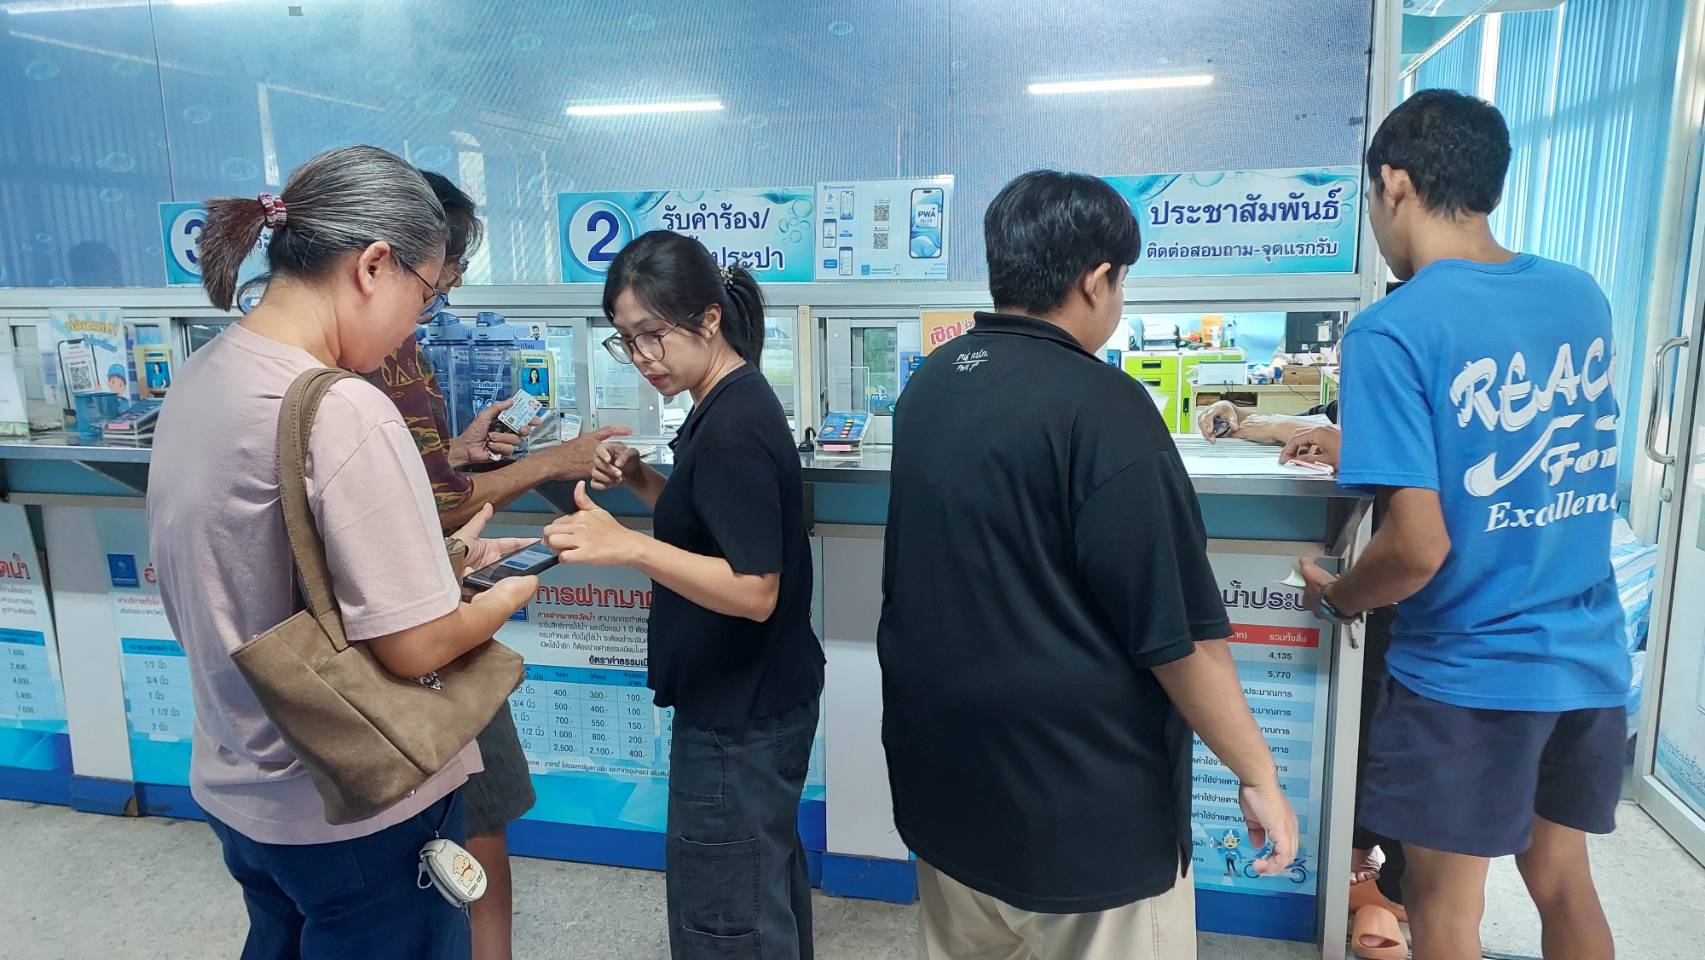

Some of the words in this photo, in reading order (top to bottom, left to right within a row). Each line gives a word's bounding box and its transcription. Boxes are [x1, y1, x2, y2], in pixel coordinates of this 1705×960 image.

[662, 202, 771, 230] รับคำร้อง/
[917, 209, 937, 218] PWA
[1151, 187, 1342, 225] ประชาสัมพันธ์
[587, 210, 620, 262] 2
[1147, 238, 1338, 261] ติดต่อสอบถาม-จุดแรกรับ
[1450, 337, 1616, 432] REAC
[1269, 652, 1292, 661] 4,135
[1268, 671, 1291, 679] 5,770
